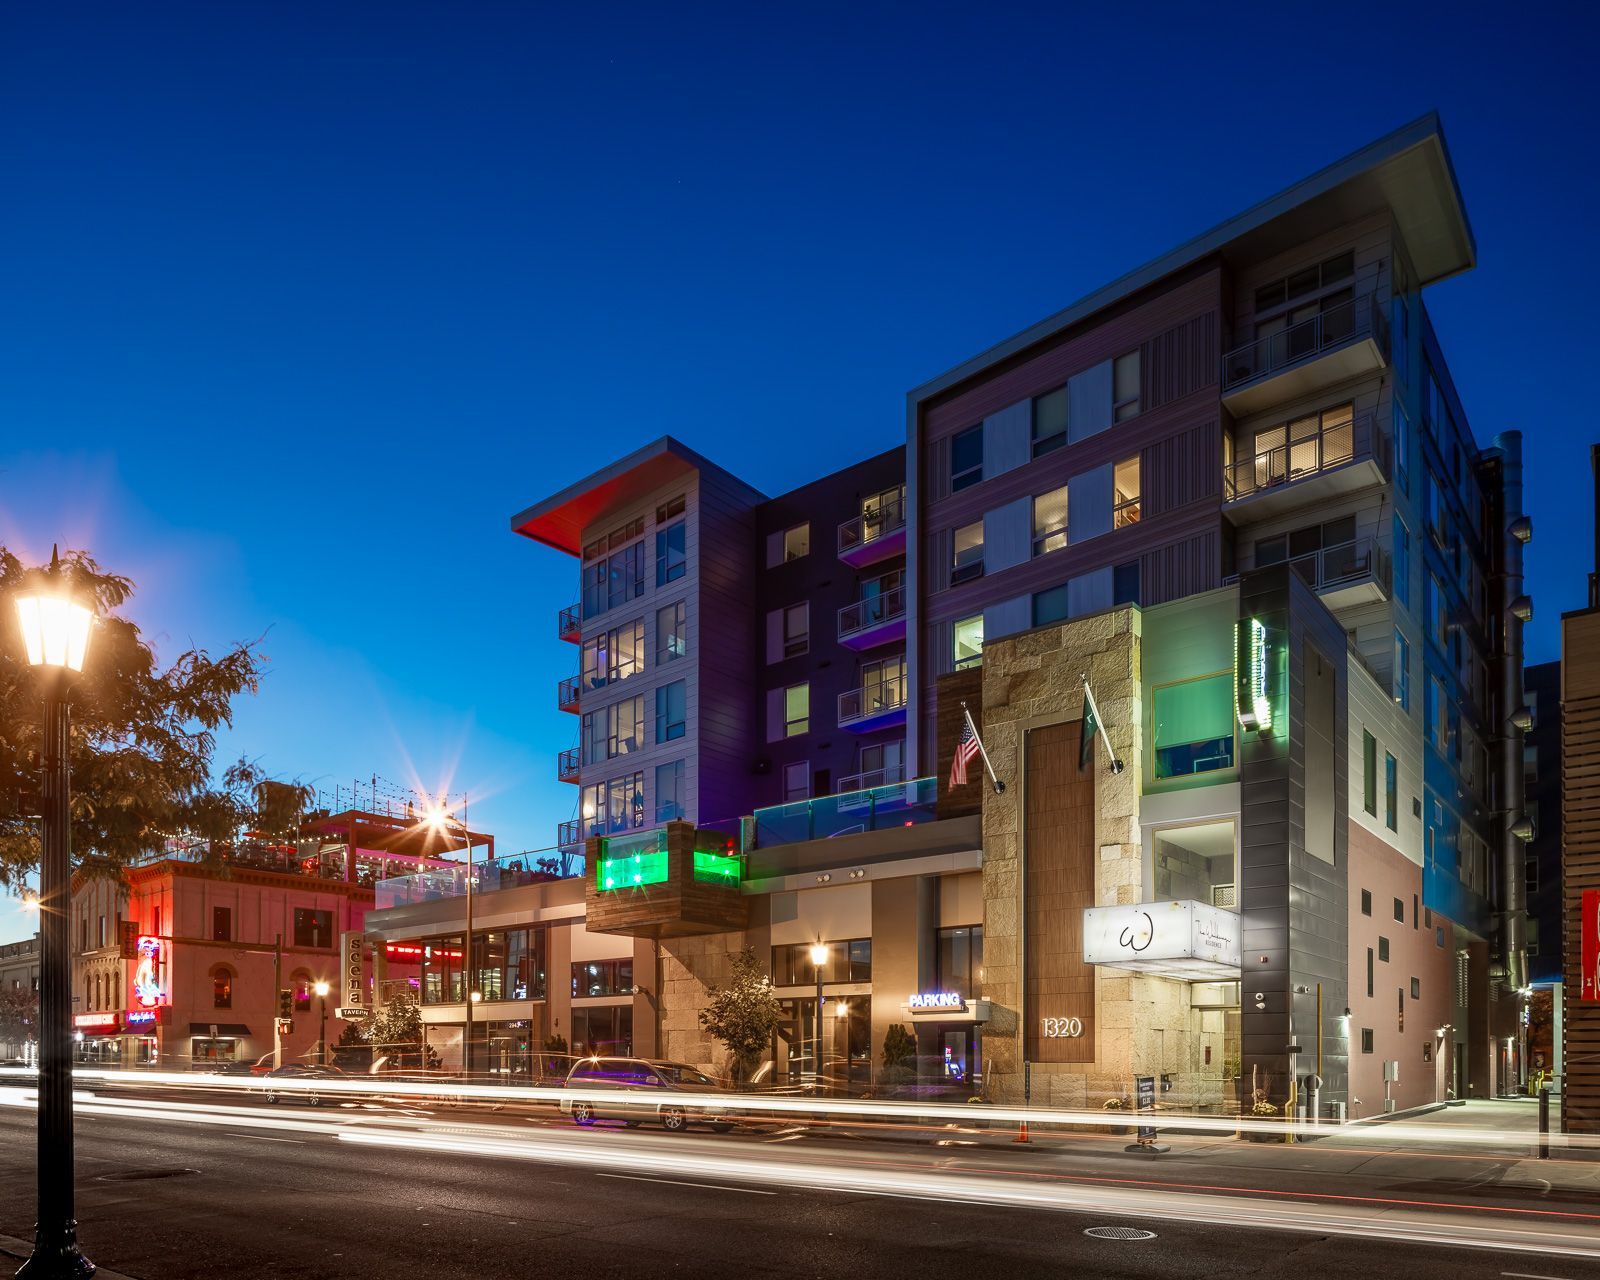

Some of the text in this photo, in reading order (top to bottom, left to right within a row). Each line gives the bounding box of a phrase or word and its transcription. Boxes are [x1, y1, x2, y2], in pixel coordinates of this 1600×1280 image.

[349, 939, 361, 1004] scena
[910, 993, 960, 1007] PARKING
[343, 1008, 369, 1016] TAVERN
[1042, 1017, 1082, 1038] 1320
